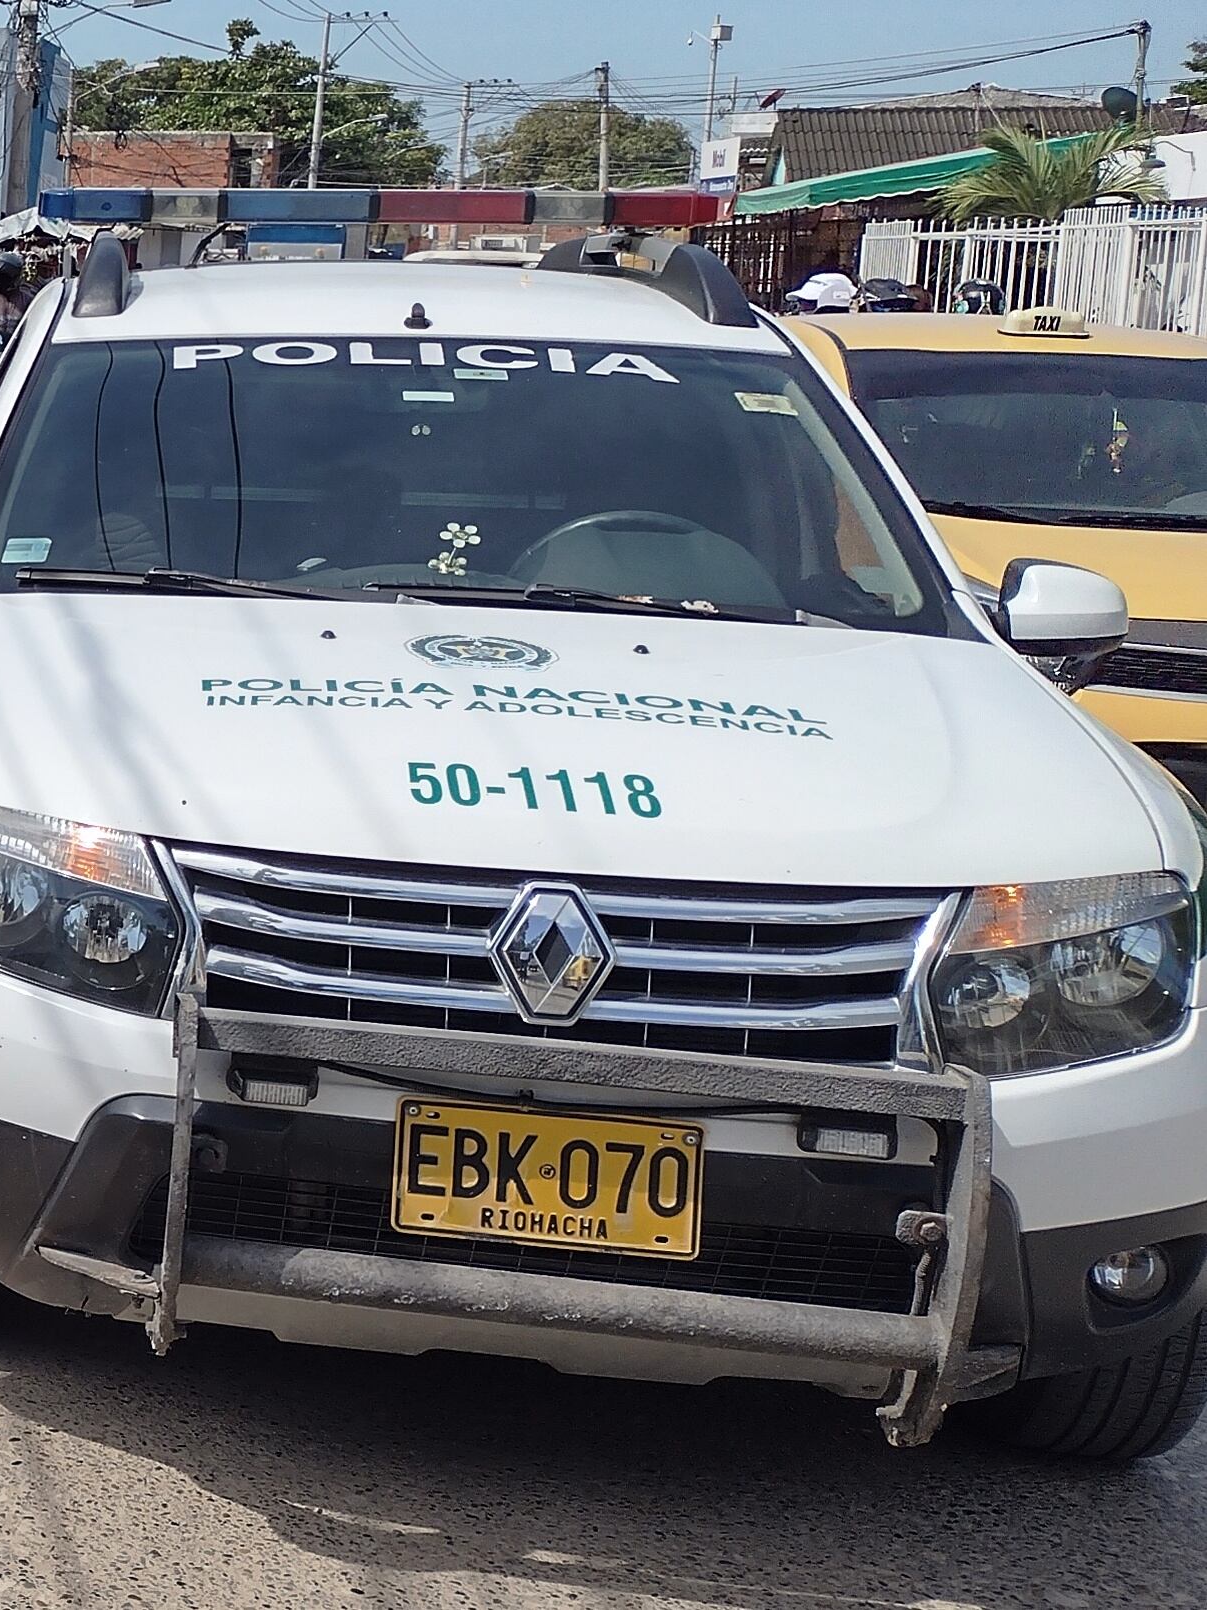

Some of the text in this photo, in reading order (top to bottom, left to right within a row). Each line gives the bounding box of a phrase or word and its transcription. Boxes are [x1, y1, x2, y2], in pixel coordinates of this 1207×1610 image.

[1033, 315, 1062, 332] TAXI
[172, 341, 682, 385] POLICIA
[201, 677, 829, 726] POLICÍA NACIONAL
[205, 694, 834, 741] INFANCIA Y ADOLESCENCIA
[406, 761, 663, 819] 50-1118
[407, 1122, 690, 1218] EBK 070
[479, 1207, 609, 1240] RIOHACHA
